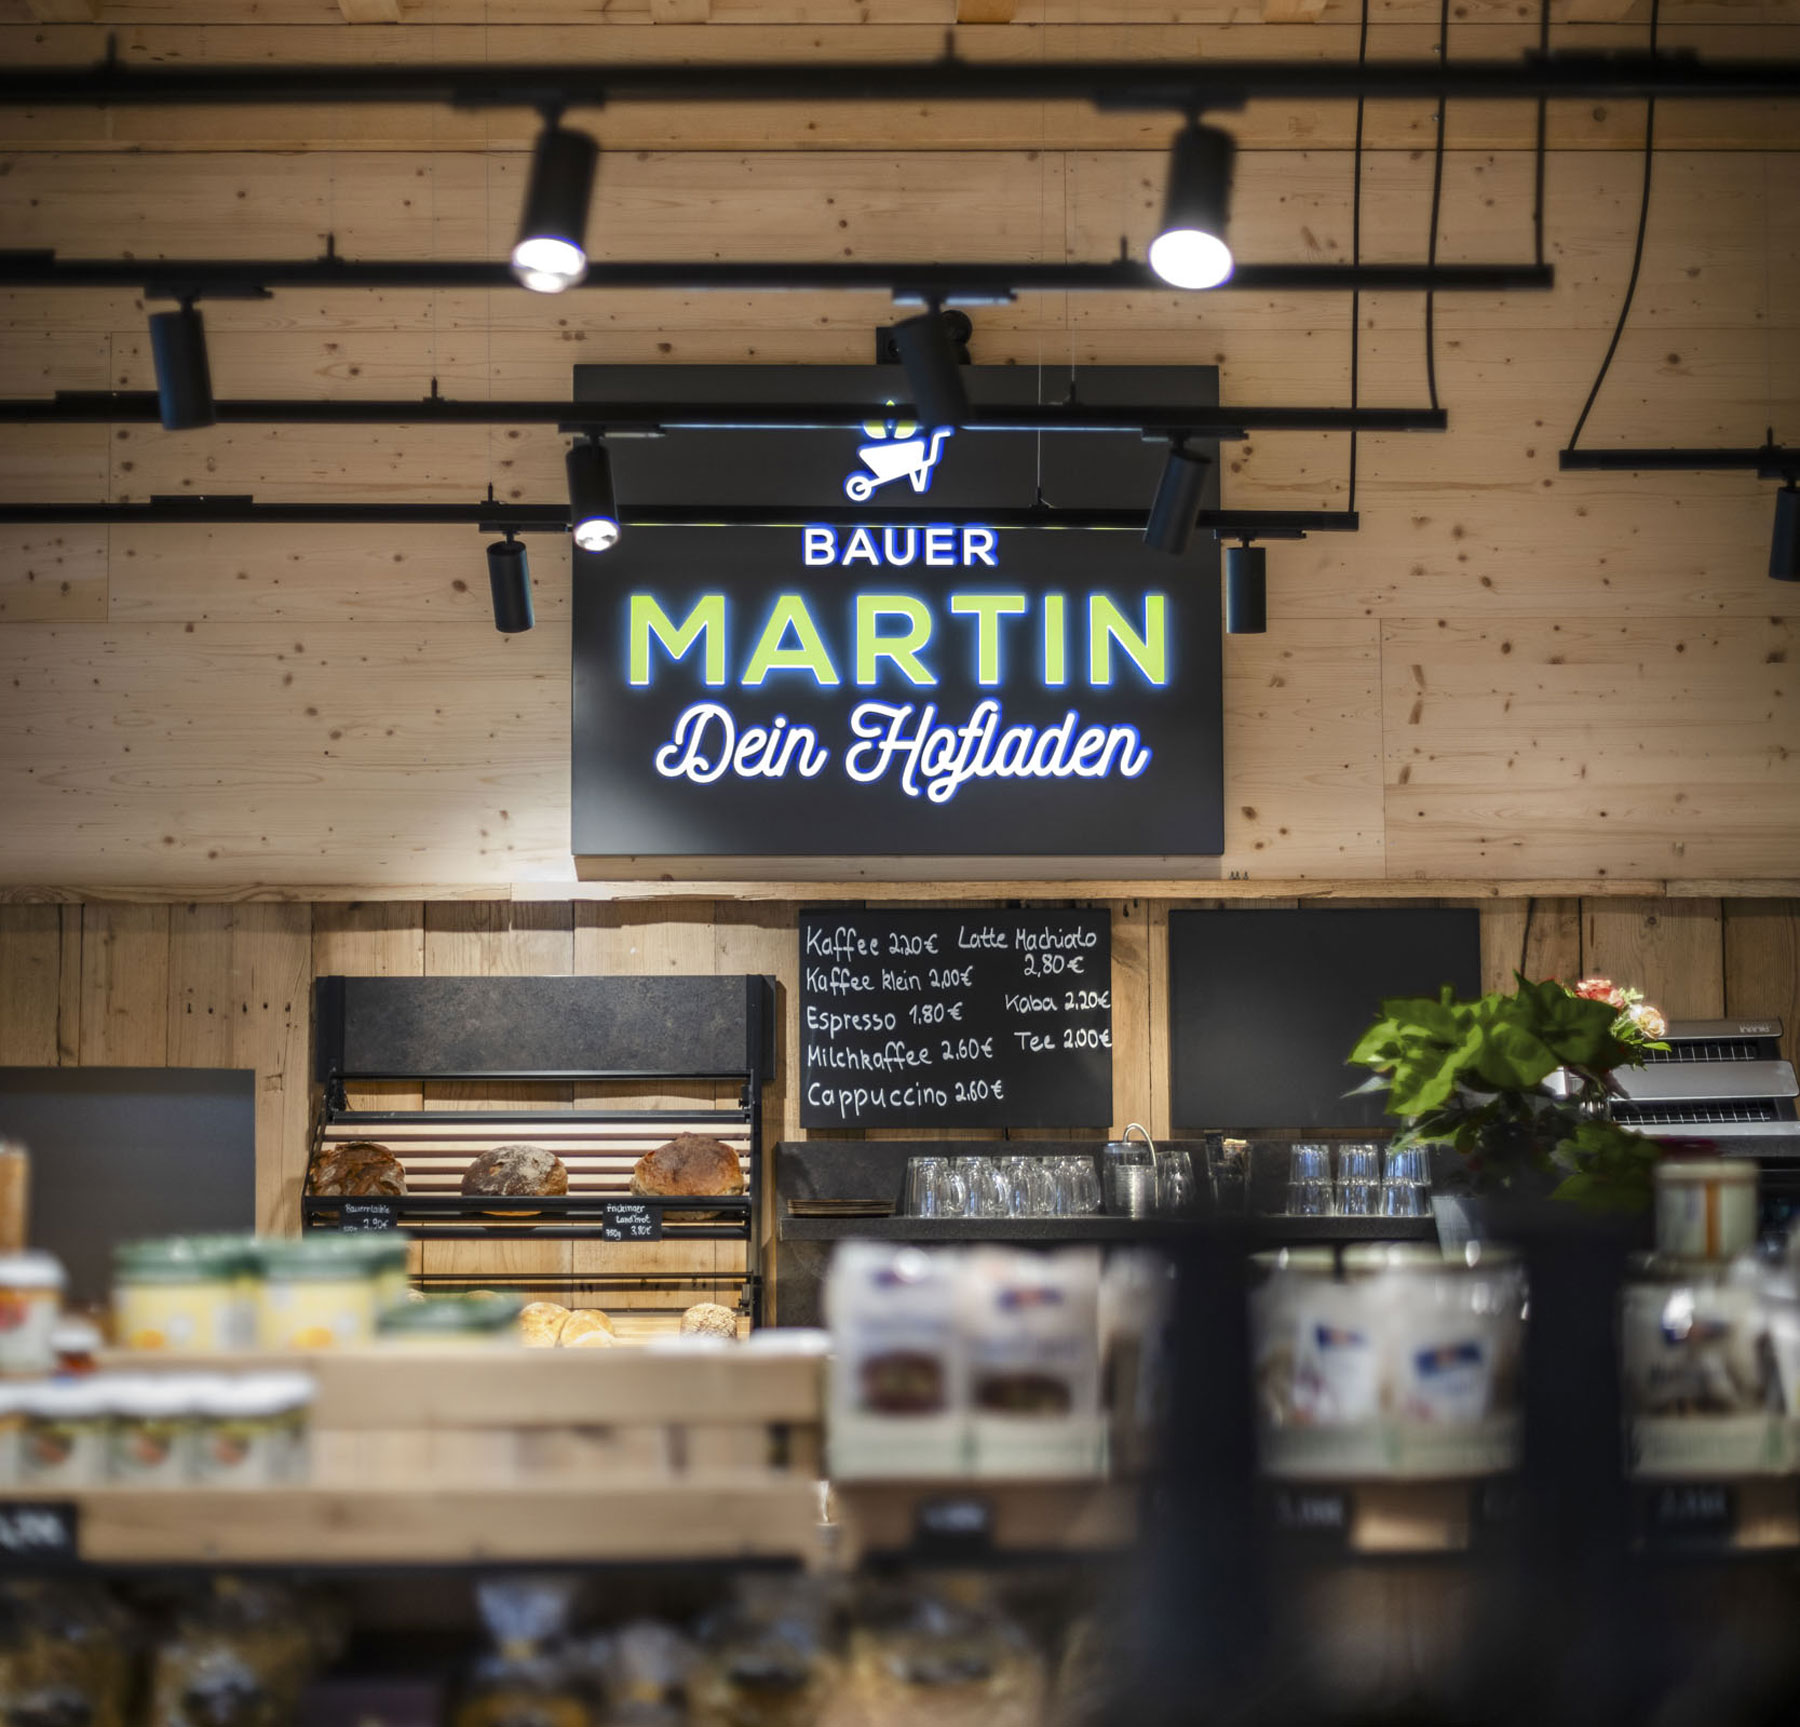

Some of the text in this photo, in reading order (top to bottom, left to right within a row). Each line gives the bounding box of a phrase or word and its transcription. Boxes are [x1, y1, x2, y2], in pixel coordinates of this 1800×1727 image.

[803, 527, 997, 567] BAUER
[629, 594, 1167, 686] MARTIN
[655, 699, 1150, 802] Dein Hofladen
[806, 925, 880, 962] Kaffee
[958, 925, 1097, 951] Latte Machiato
[806, 966, 875, 997] Kaffee
[881, 968, 922, 992] klein
[1004, 994, 1058, 1014] Kaba
[806, 1005, 897, 1040] Espresso
[807, 1040, 933, 1073] Milchkaffee
[1013, 1031, 1056, 1052] Tee
[807, 1081, 948, 1120] Cappuccino
